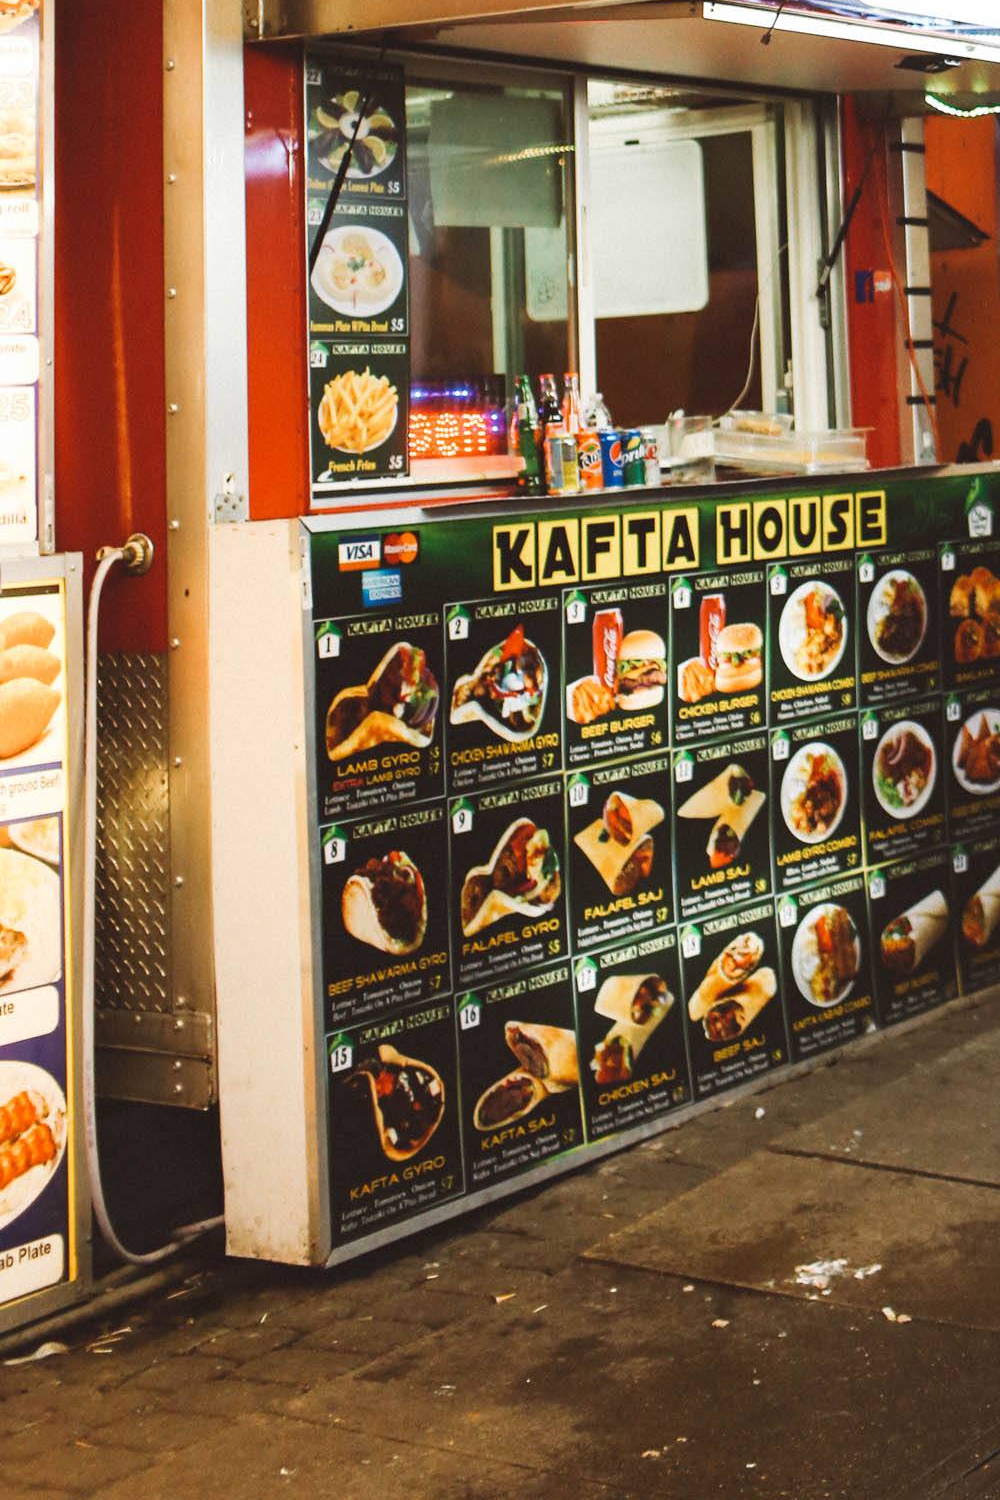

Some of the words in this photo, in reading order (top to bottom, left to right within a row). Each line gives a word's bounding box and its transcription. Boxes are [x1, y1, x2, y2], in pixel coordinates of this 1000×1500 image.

[387, 181, 400, 194] $5
[391, 318, 404, 332] $5
[333, 344, 370, 355] KAFTA
[371, 344, 406, 355] HOUSE
[329, 460, 355, 472] French
[357, 459, 377, 471] Fries
[389, 455, 403, 469] $5
[0, 509, 27, 525] dilla
[346, 544, 373, 561] VISA
[495, 509, 699, 589] KAFTA
[718, 492, 886, 564] HOUSE
[590, 588, 628, 604] KAFTA
[630, 584, 665, 598] HOUSE
[475, 602, 516, 619] KAFTA
[518, 597, 558, 613] HOUSE
[347, 618, 392, 636] KAFTA
[395, 613, 439, 630] HOUSE
[679, 703, 718, 720] CHICKEN
[719, 695, 759, 712] BURGER
[581, 724, 608, 739] BEEF
[610, 714, 655, 732] BURGER
[451, 749, 486, 766] CHICKEN
[536, 733, 559, 749] GYRO
[542, 753, 554, 767] $7
[336, 755, 378, 777] LAMB
[382, 751, 421, 768] GYRO
[366, 771, 393, 785] LAMB
[395, 766, 421, 780] GYRO
[593, 767, 630, 785] KAFTA
[631, 759, 668, 777] HOUSE
[479, 792, 519, 810] KAFTA
[521, 783, 560, 800] HOUSE
[353, 820, 395, 838] KAFTA
[400, 810, 443, 827] HOUSE
[691, 872, 725, 891] LAMB
[726, 864, 751, 880] SAJ
[584, 897, 637, 921] FALAFEL
[637, 888, 664, 905] SAJ
[656, 908, 668, 923] $7
[462, 935, 519, 956] FALAFEL
[521, 918, 560, 939] GYRO
[328, 979, 354, 996] BEEF
[356, 962, 417, 987] SHAWARMA
[418, 952, 448, 970] GYRO
[713, 1044, 740, 1063] BEEF
[742, 1034, 766, 1051] SAJ
[598, 1082, 649, 1106] CHICKEN
[650, 1069, 677, 1087] SAJ
[481, 1126, 525, 1150] KAFTA
[528, 1114, 557, 1134] SAJ
[350, 1175, 399, 1200] KAFTA
[403, 1156, 446, 1181] GYRO
[19, 1242, 51, 1263] Plate
